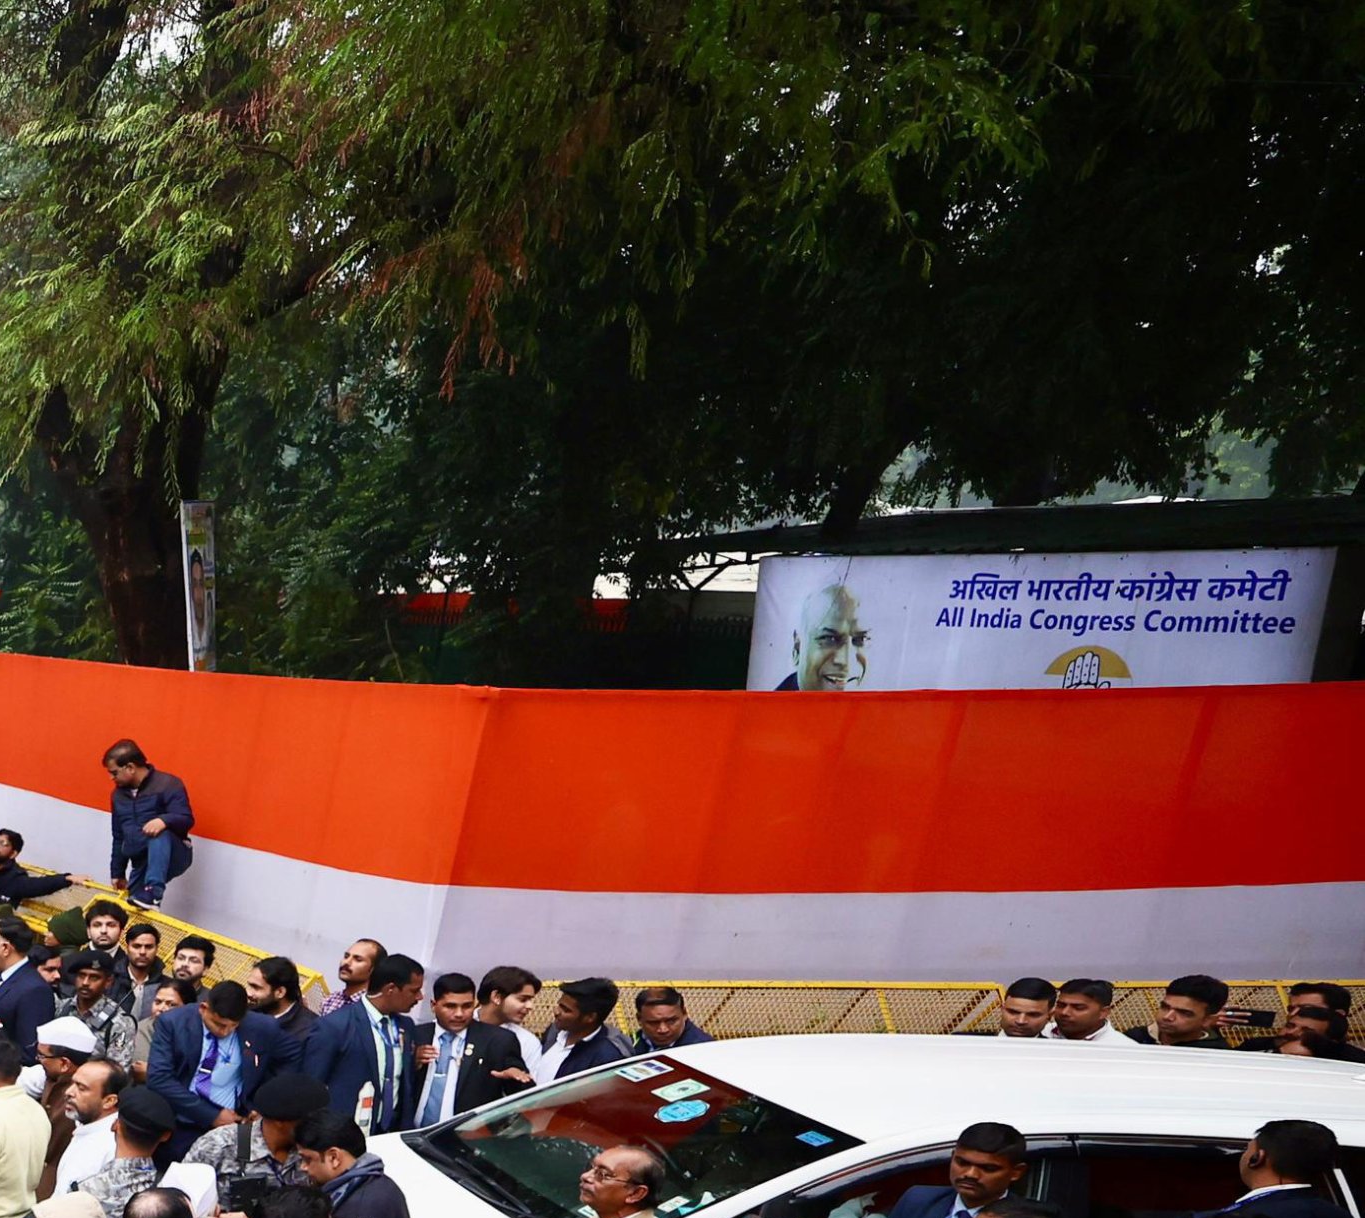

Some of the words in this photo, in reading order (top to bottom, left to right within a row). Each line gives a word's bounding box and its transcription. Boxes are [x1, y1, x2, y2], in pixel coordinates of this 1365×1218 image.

[949, 572, 1022, 600] अखिल
[1027, 572, 1115, 600] भारतीय
[1120, 570, 1202, 600] कांग्रेस
[1207, 569, 1292, 600] कमेटी
[936, 607, 965, 628] All
[970, 608, 1022, 629] India
[1029, 608, 1135, 636] Congress
[1144, 609, 1295, 633] Committee
